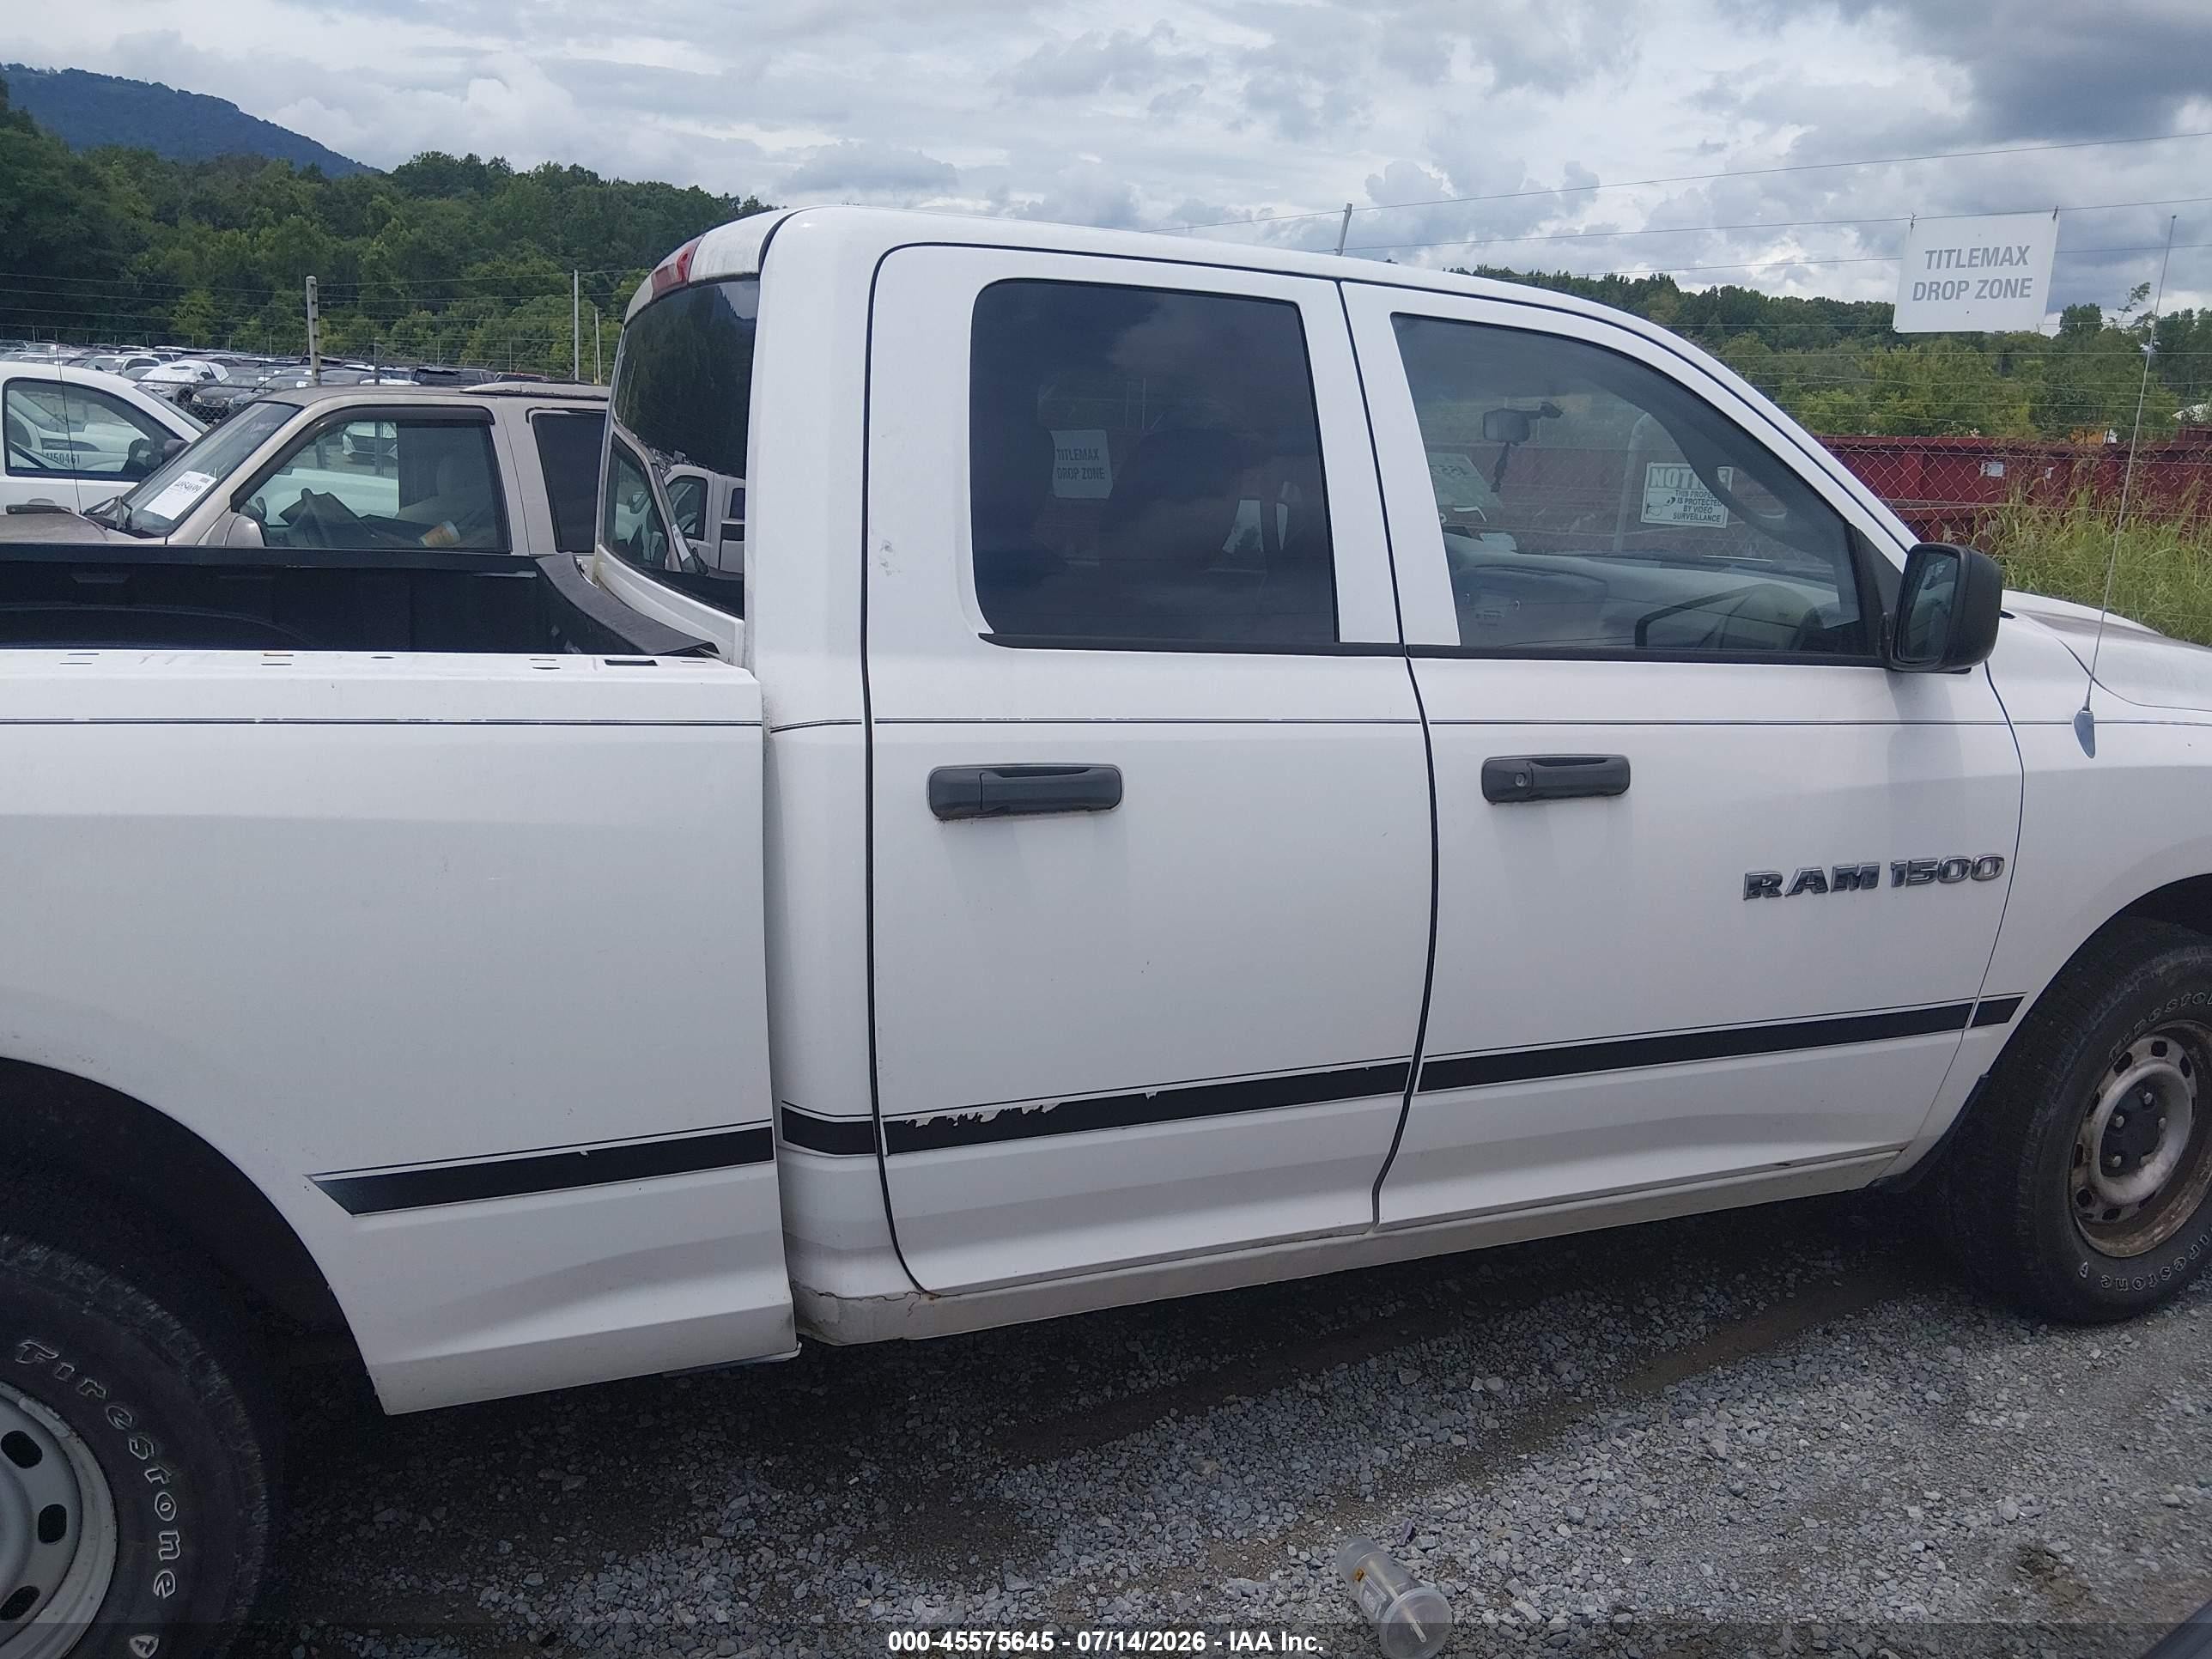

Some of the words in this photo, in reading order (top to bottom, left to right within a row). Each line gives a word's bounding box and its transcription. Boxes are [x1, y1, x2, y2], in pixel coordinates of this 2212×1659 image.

[1925, 246, 2031, 270] TITLEMAX
[1912, 280, 1970, 301] DROP
[1975, 277, 2033, 300] ZONE
[1056, 447, 1099, 461] TITLEMAX
[1057, 467, 1079, 481] DROP
[1082, 467, 1105, 480] ZONE
[1684, 497, 1722, 507] PROTECTED
[1673, 512, 1722, 523] SURVEILLANCE
[1743, 864, 1881, 901] RAM
[1890, 854, 2006, 888] 1500
[2100, 1226, 2212, 1291] irestone
[15, 1339, 181, 1599] Firestone
